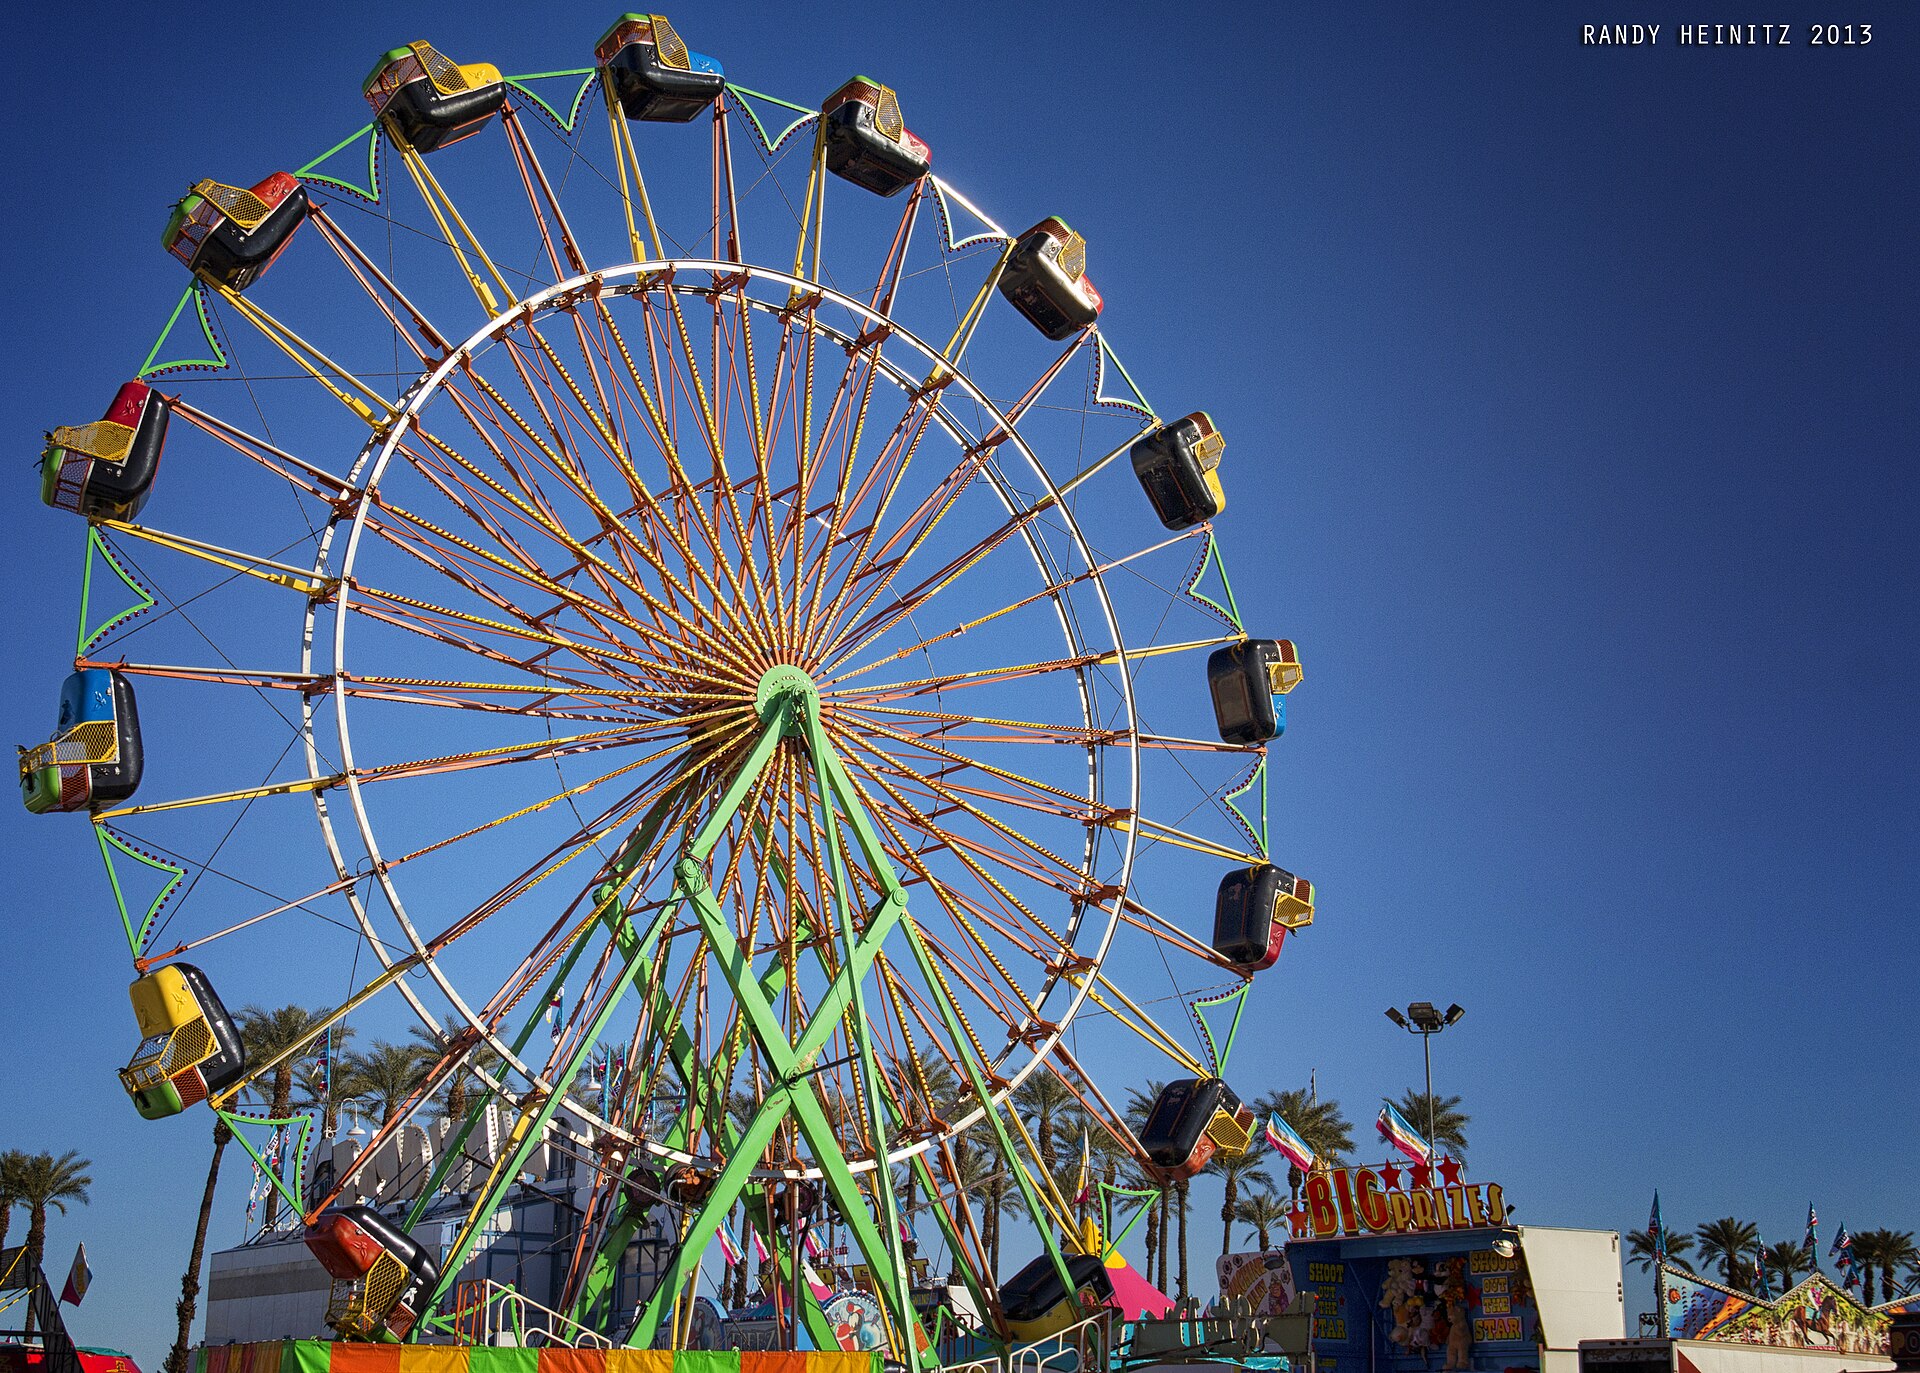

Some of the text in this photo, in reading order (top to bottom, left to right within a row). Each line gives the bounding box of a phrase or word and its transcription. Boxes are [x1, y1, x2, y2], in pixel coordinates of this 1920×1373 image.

[1305, 1166, 1505, 1238] BIG PRIZES
[1309, 1262, 1345, 1284] SHOOT
[1318, 1285, 1336, 1299] OUT
[1483, 1277, 1507, 1293] OUT
[1318, 1301, 1338, 1316] THE
[1483, 1297, 1510, 1314] THE
[1474, 1318, 1522, 1341] STAR
